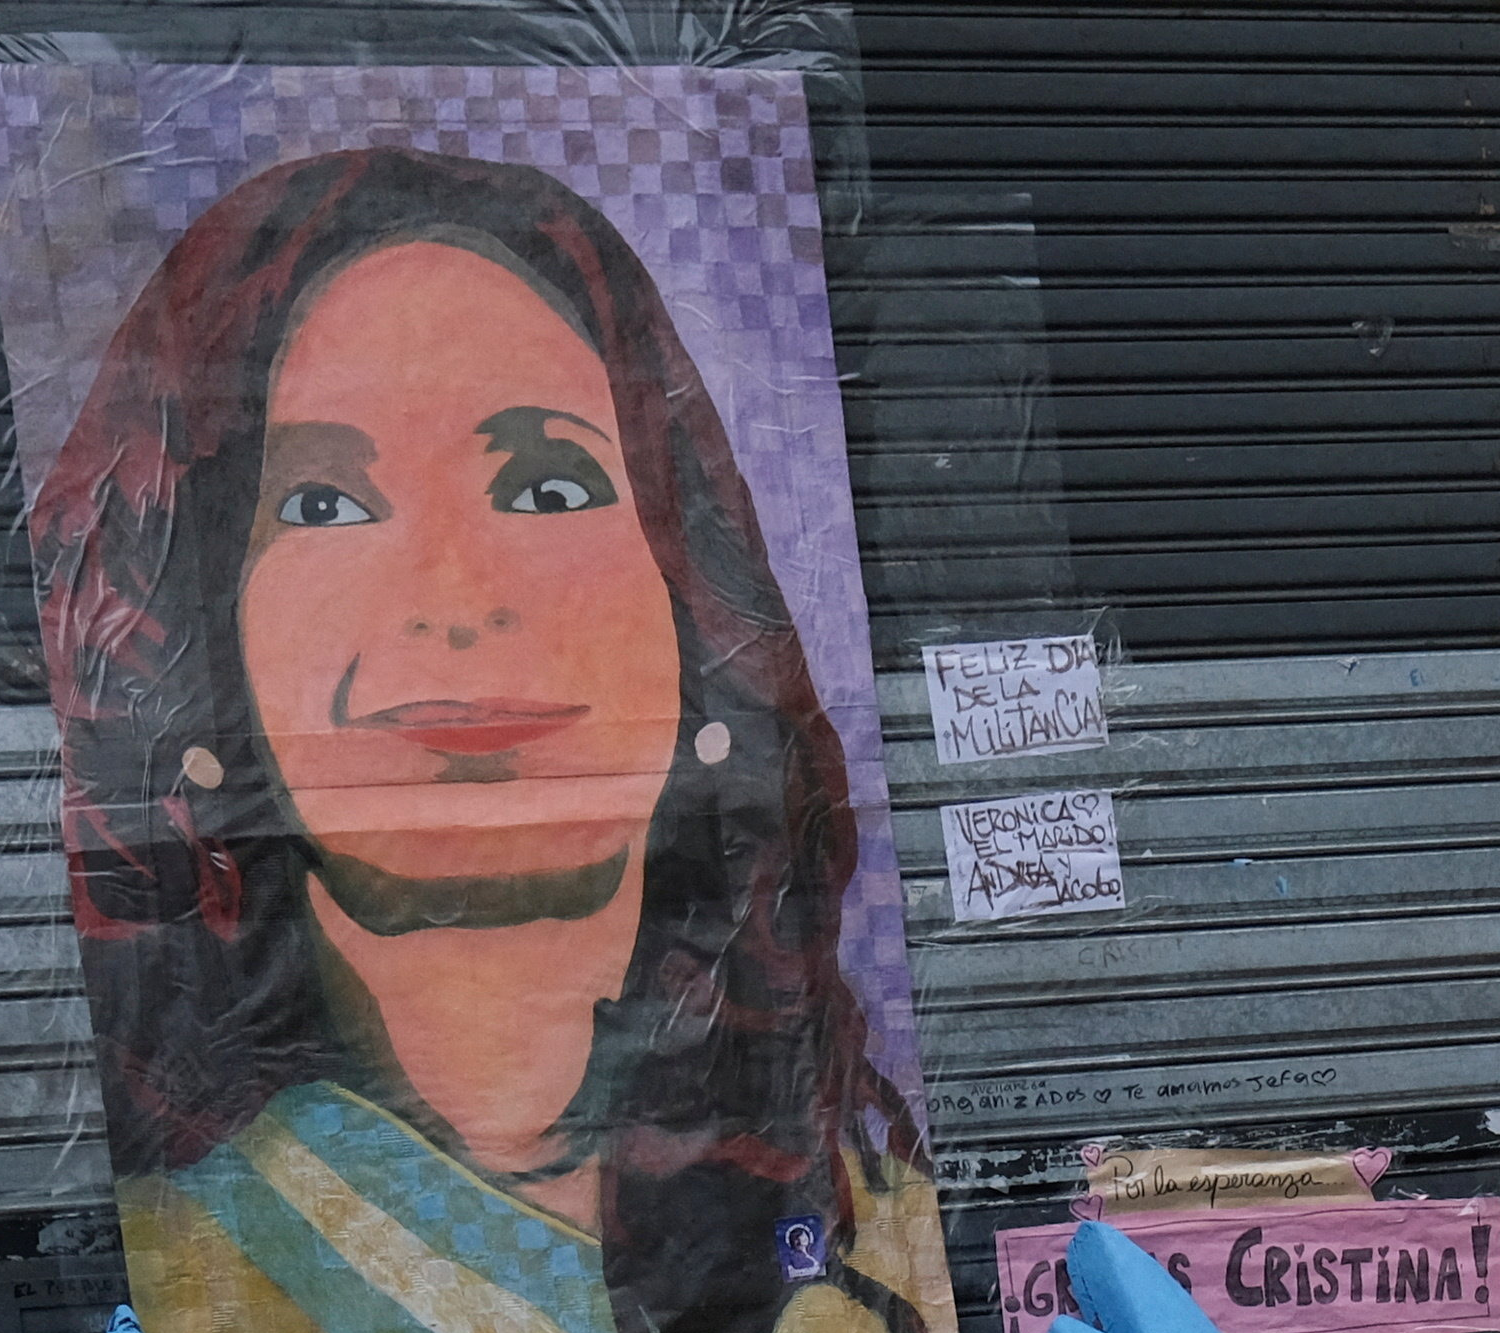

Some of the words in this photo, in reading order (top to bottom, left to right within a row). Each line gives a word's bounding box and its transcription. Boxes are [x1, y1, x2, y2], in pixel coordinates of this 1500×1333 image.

[953, 685, 997, 713] DE
[1000, 675, 1040, 700] LA
[974, 836, 1013, 859] EL
[1103, 1155, 1147, 1202] Por
[1153, 1168, 1181, 1199] la
